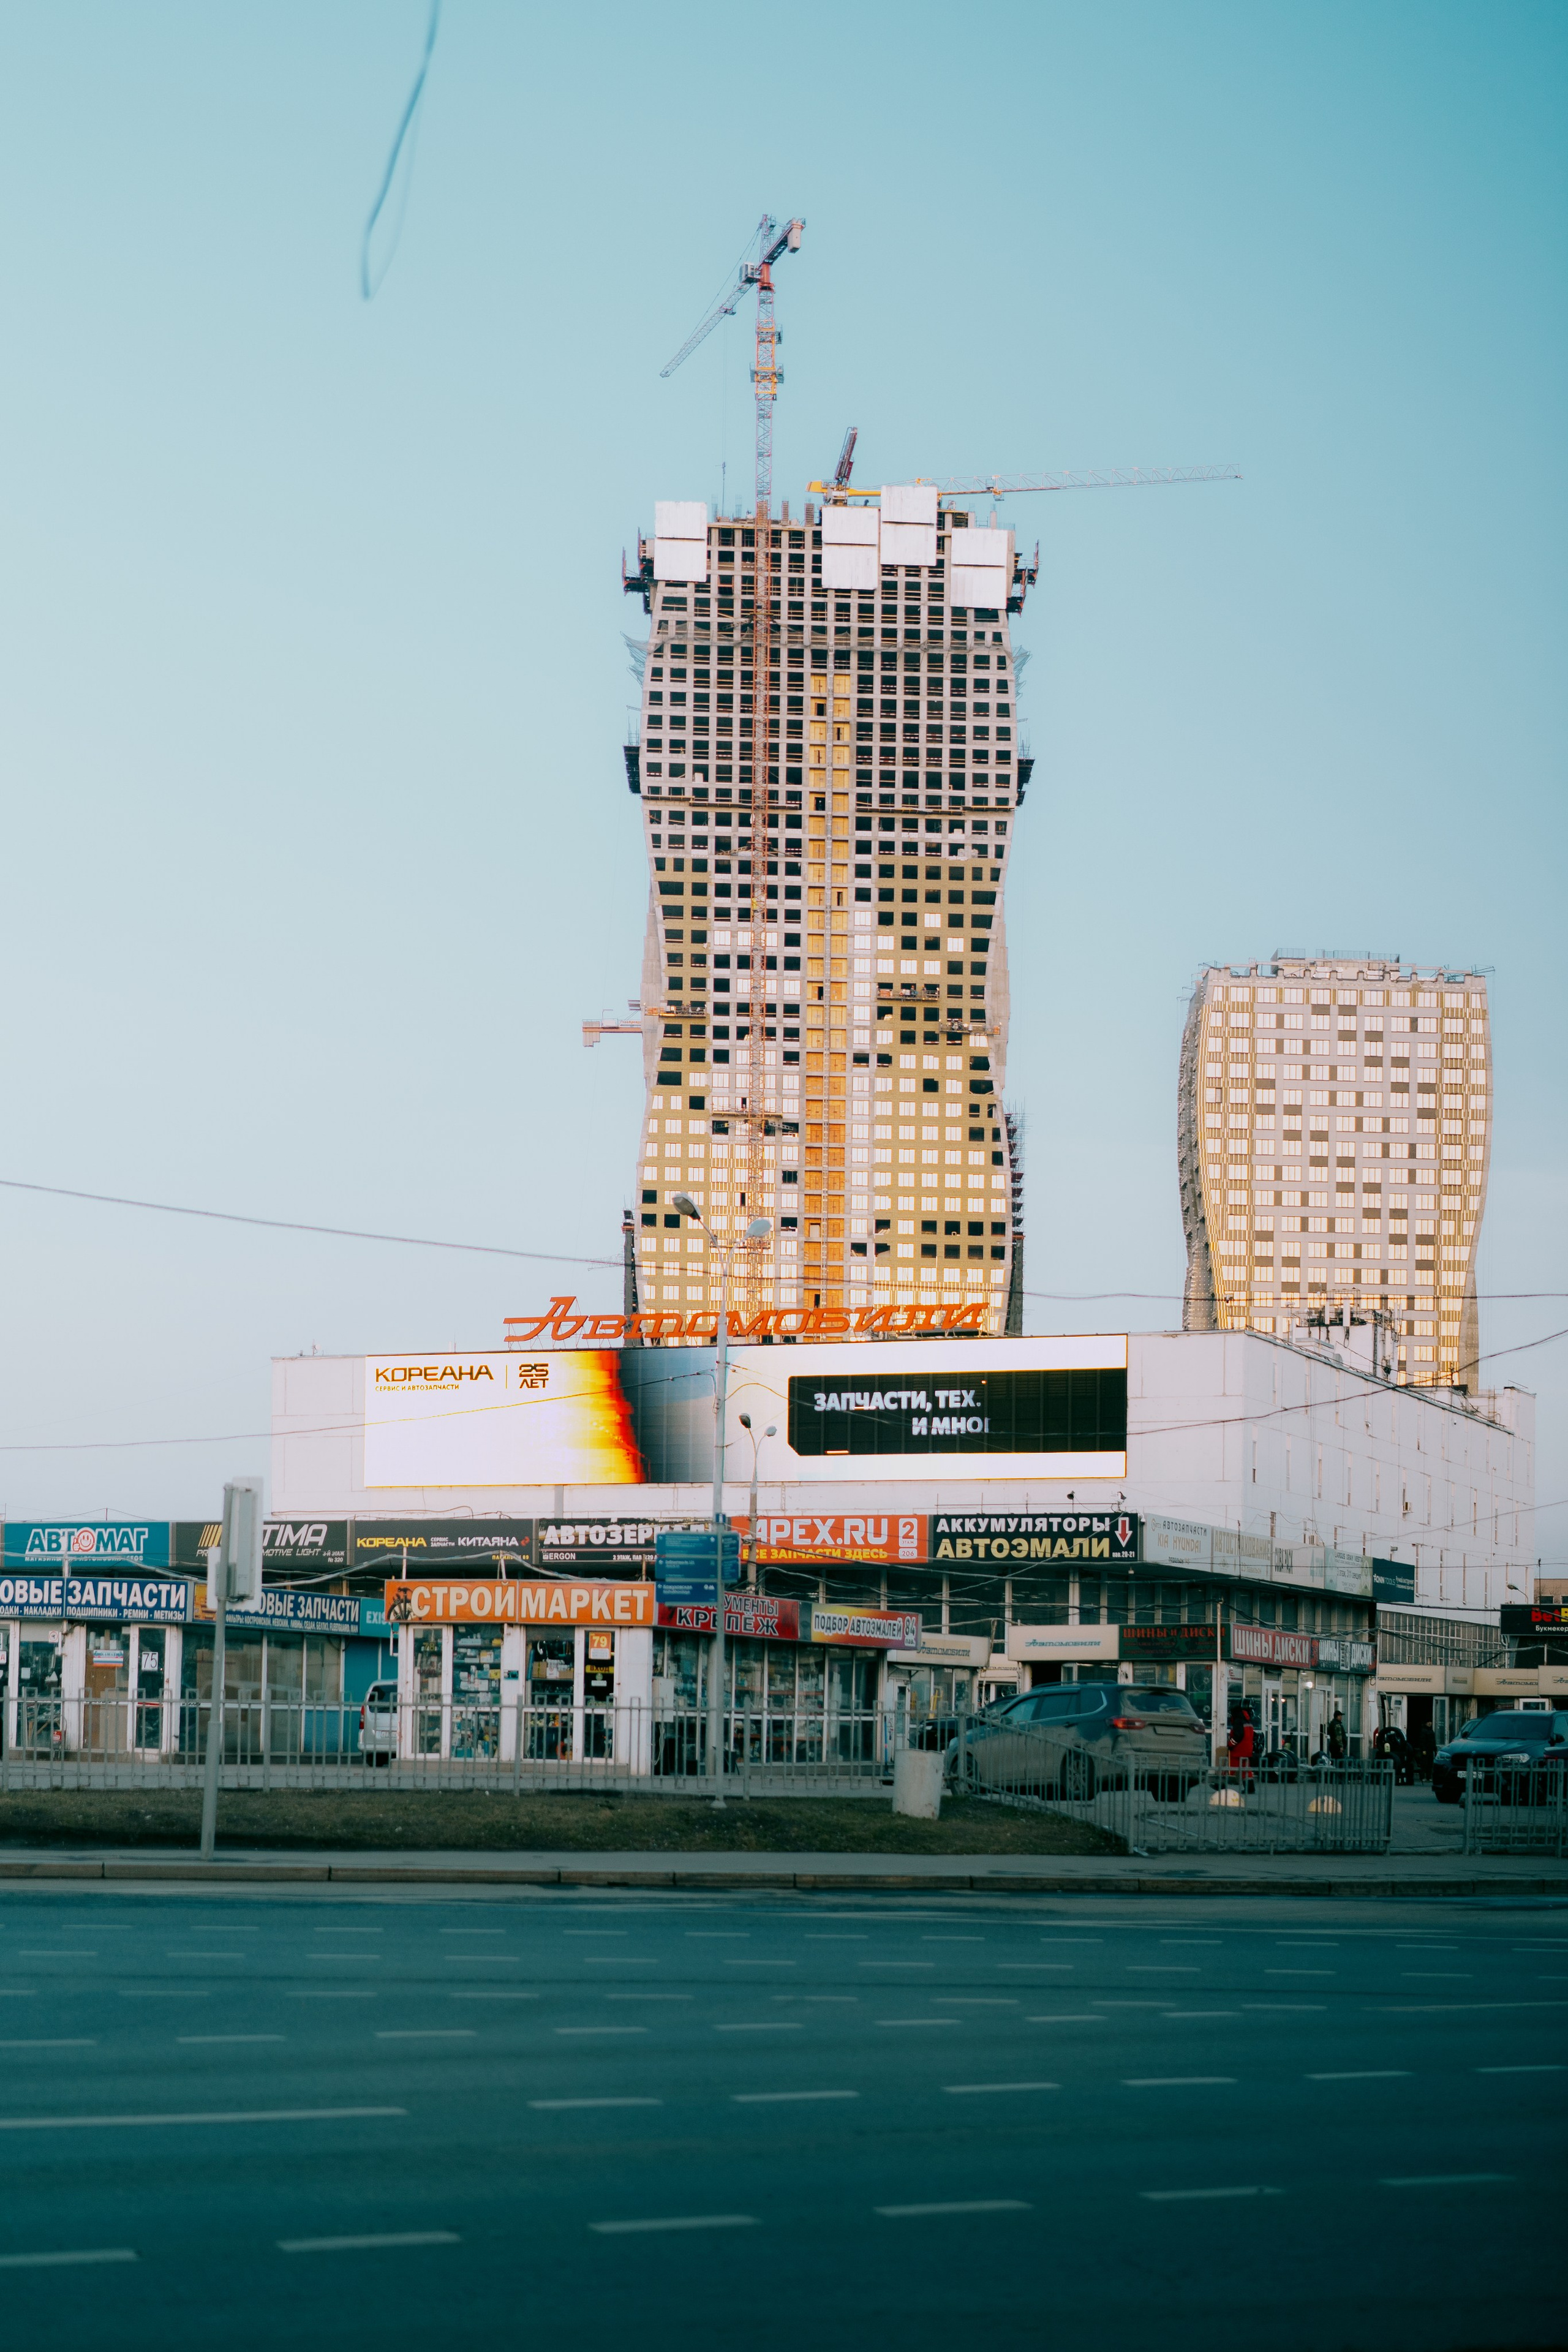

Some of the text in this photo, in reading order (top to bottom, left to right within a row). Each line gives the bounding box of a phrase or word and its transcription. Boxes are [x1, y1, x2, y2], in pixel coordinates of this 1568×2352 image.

[503, 1295, 989, 1341] Автомобили
[375, 1365, 494, 1382] КОРЕАНА
[519, 1363, 549, 1377] 25
[519, 1378, 549, 1389] ЛЕТ
[814, 1389, 981, 1412] ЗАПЧАСТИ, ТЕХ.
[912, 1417, 927, 1435] И
[902, 1521, 914, 1539] 2
[936, 1517, 1110, 1532] АККУМУЛЯТОРЫ
[1163, 1520, 1207, 1536] АВТОЗАПЧАСТИ
[357, 1537, 427, 1547] КОРЕАНА
[458, 1537, 519, 1547] КИТАЯНА
[936, 1537, 1109, 1558] АВТОЭМАЛИ
[1158, 1533, 1201, 1553] KIA HYUNDAI
[771, 1548, 841, 1559] ЗАПЧАСТИ
[845, 1548, 888, 1560] ЗДЕСЬ
[67, 1580, 185, 1608] ЗАПЧАСТИ
[24, 1606, 61, 1616] НАКЛАДКИ
[67, 1606, 118, 1618] ПОДШИПНИКИ
[123, 1608, 149, 1619] РЕМНИ
[154, 1610, 184, 1620] МЕТИЗЫ
[297, 1596, 359, 1622] ЗАПЧАСТИ
[366, 1610, 390, 1625] EXIS
[814, 1613, 902, 1638] ПОДБОР АВТОЭМАЛЕЙ
[904, 1618, 916, 1636] 84
[1123, 1628, 1167, 1638] ШИНЫ
[1180, 1627, 1225, 1638] ДИСКИ
[592, 1635, 608, 1648] 79
[1234, 1629, 1309, 1664] ШИНЫ ДИСКИ
[142, 1653, 157, 1669] 75
[1319, 1640, 1371, 1668] ШИНЫ ДИСКИ
